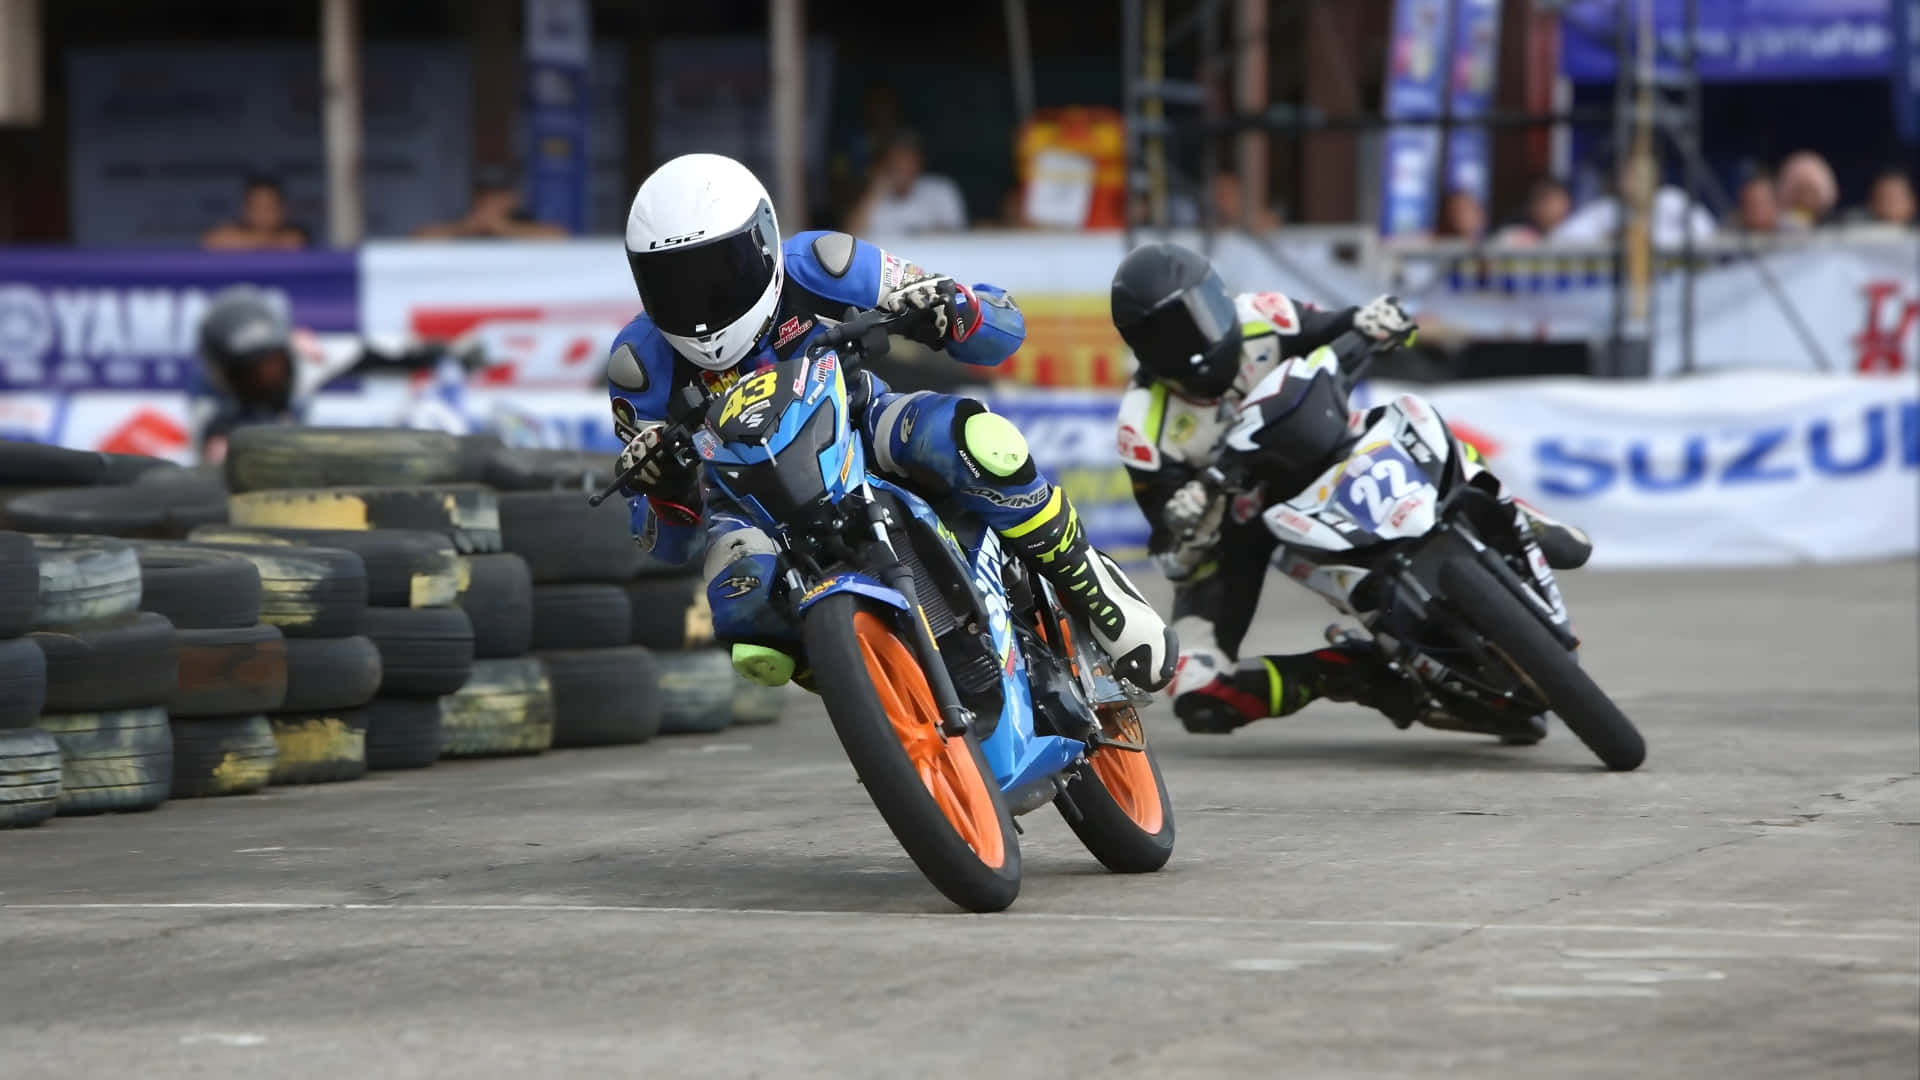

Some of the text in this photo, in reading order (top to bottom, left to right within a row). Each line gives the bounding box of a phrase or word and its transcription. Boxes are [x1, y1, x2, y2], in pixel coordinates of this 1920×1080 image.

[649, 230, 705, 250] LS2
[53, 287, 291, 357] YAMA
[719, 371, 778, 428] 43
[1534, 401, 1920, 499] SUZU
[1351, 459, 1424, 525] 22
